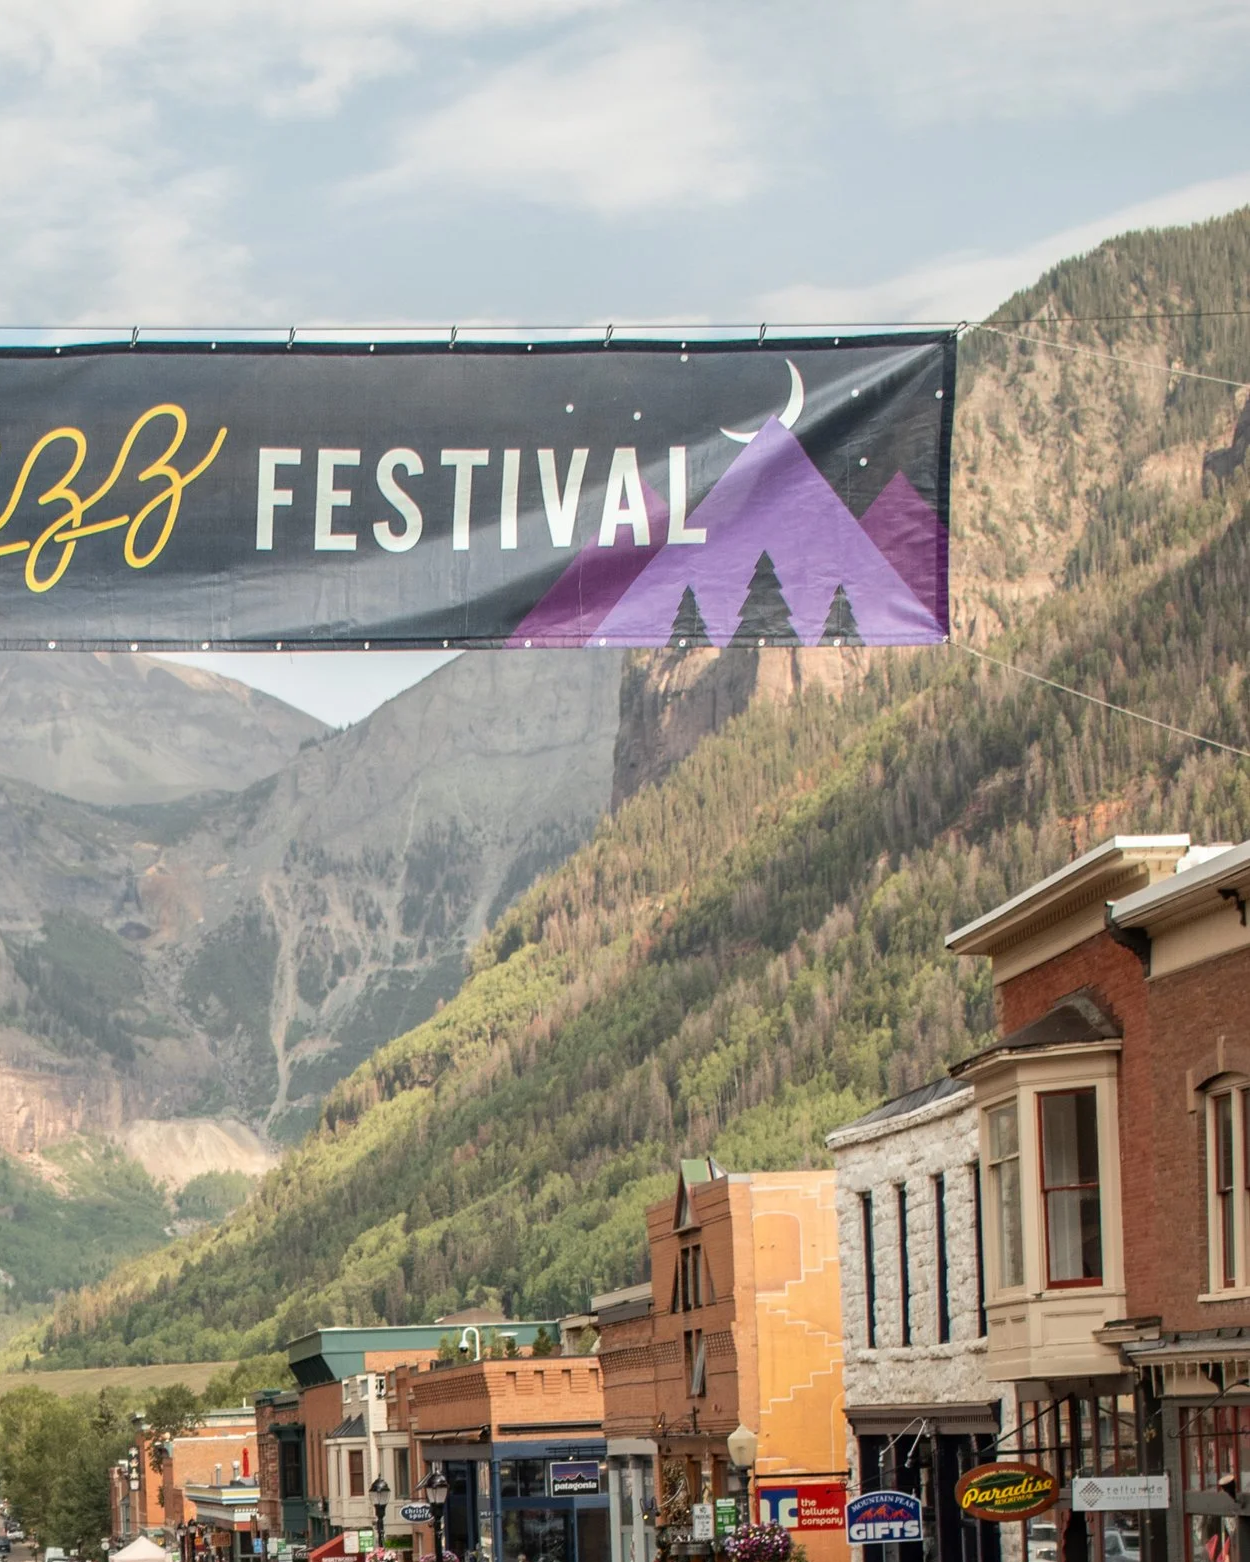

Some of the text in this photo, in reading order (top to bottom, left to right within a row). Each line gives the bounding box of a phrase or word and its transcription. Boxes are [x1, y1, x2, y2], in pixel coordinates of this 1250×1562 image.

[254, 445, 709, 553] FESTIVAL
[554, 1481, 598, 1492] patagonia
[961, 1476, 1053, 1509] Paradise
[801, 1498, 817, 1507] the
[851, 1495, 916, 1513] MOUNTAIN PEAK
[801, 1507, 840, 1516] telluride
[801, 1516, 843, 1526] company
[849, 1520, 920, 1541] GIFTS
